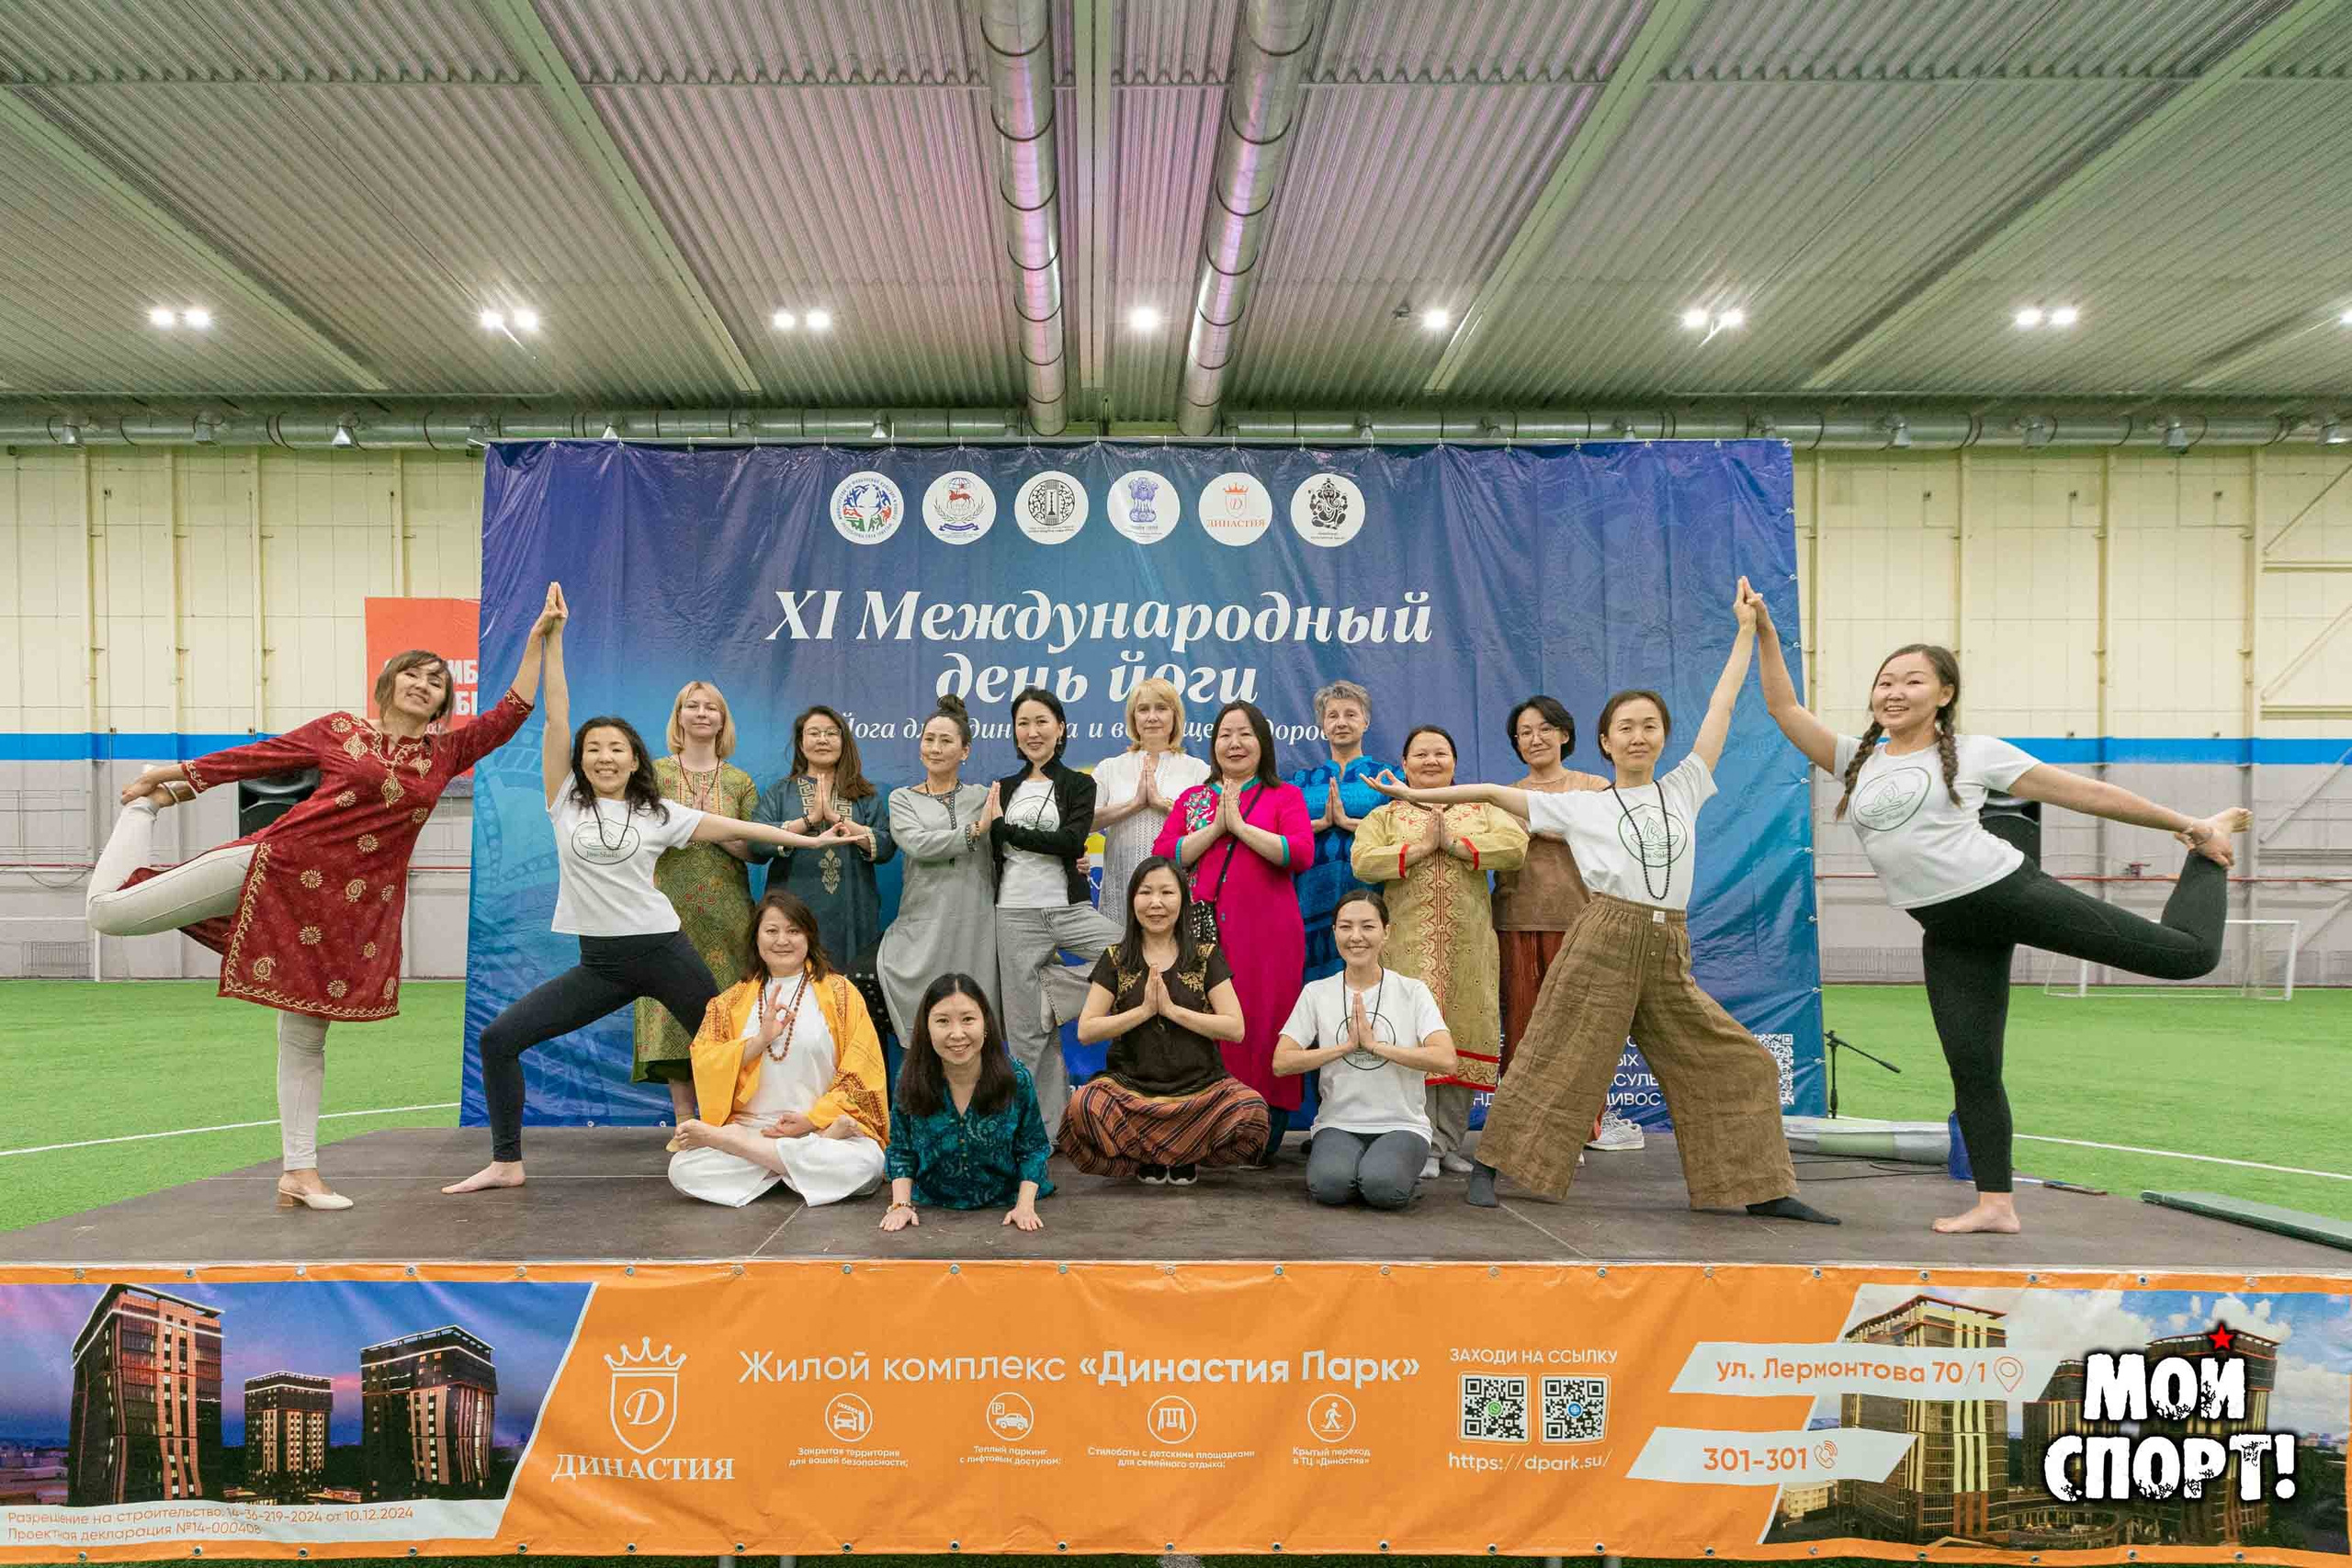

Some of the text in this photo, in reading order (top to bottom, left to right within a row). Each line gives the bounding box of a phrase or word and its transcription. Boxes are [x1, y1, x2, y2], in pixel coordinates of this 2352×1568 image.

[765, 591, 1434, 653] XI Международный
[935, 649, 1258, 705] день йоги
[738, 1348, 1420, 1390] Жилой комплекс «Династия Парк»
[1450, 1348, 1617, 1365] ЗАХОДИ НА ССЫЛКУ
[1716, 1358, 1987, 1386] ул. Лермонтова 70/1
[551, 1454, 735, 1483] ДИНАСТИЯ
[1702, 1448, 1808, 1472] 301-301
[93, 1515, 112, 1524] на
[325, 1513, 341, 1521] от
[344, 1507, 413, 1521] 10.12.2024
[81, 1525, 172, 1542] декларация
